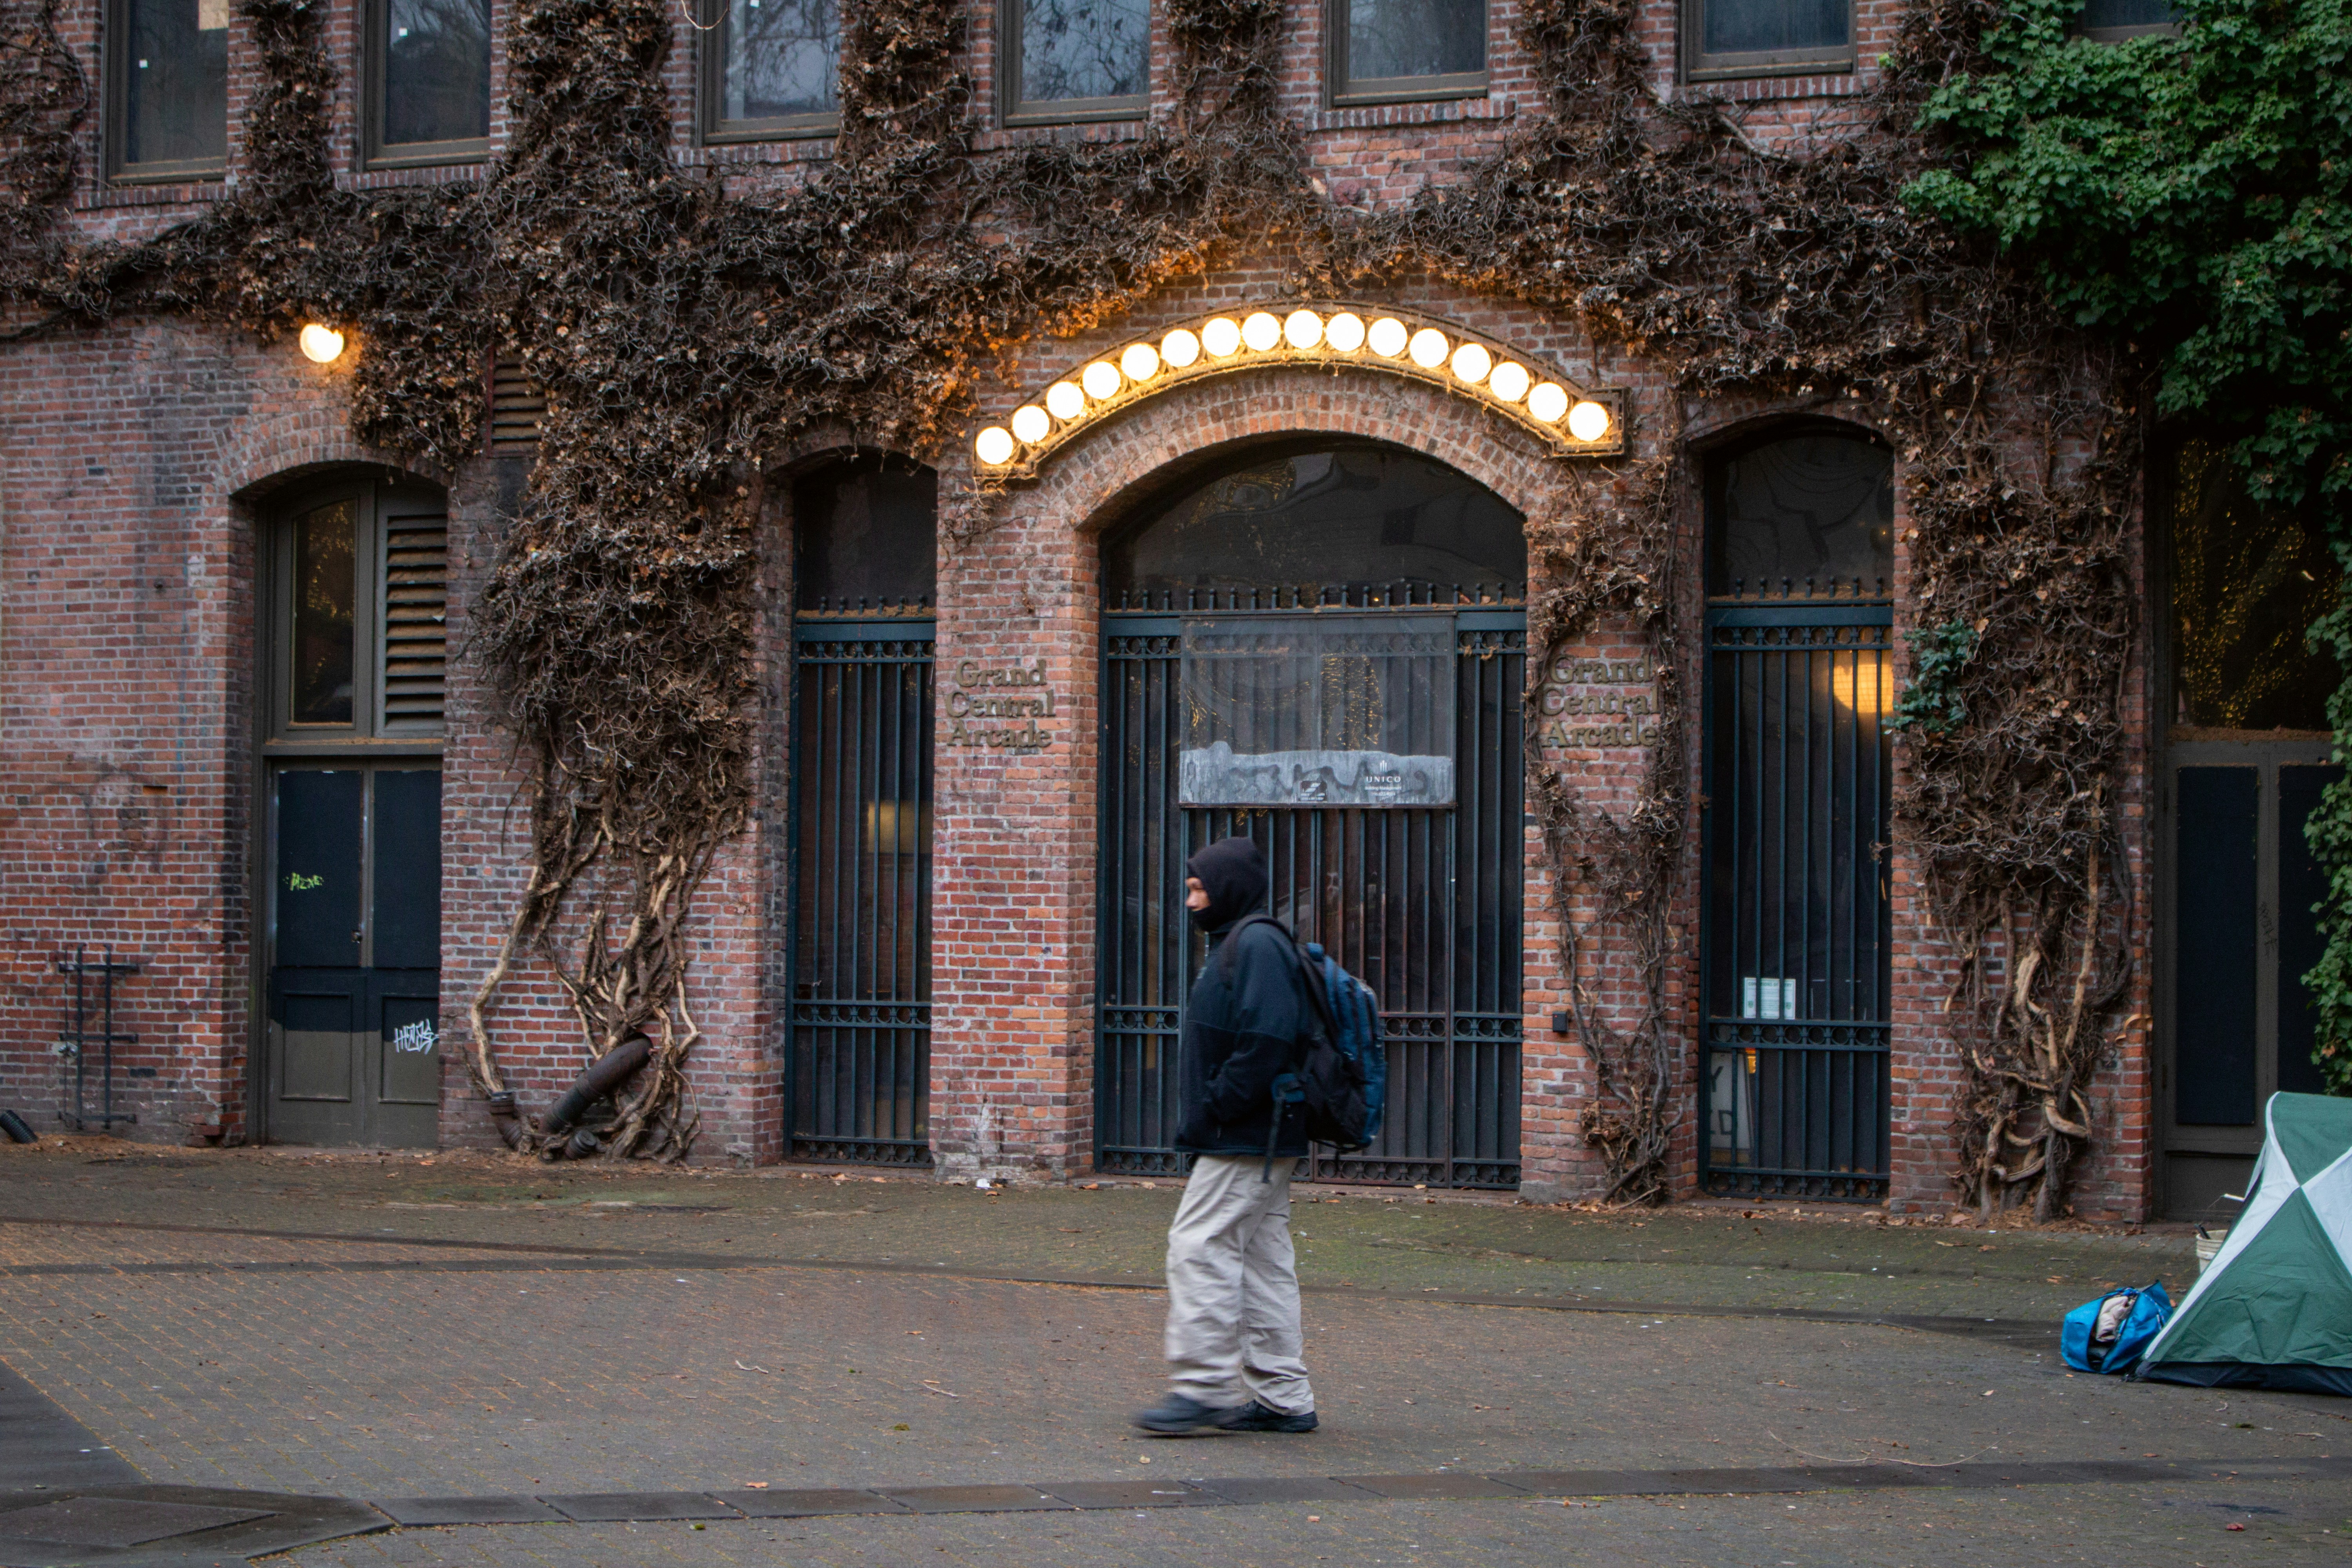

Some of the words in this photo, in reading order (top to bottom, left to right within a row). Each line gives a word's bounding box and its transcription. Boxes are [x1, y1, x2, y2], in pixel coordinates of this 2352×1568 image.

[955, 659, 1047, 687] Grand
[1551, 653, 1653, 683] Grand
[945, 689, 1056, 717] Central
[1542, 685, 1661, 715] Central
[947, 719, 1053, 748] Arcade
[1542, 716, 1659, 747] Arcade
